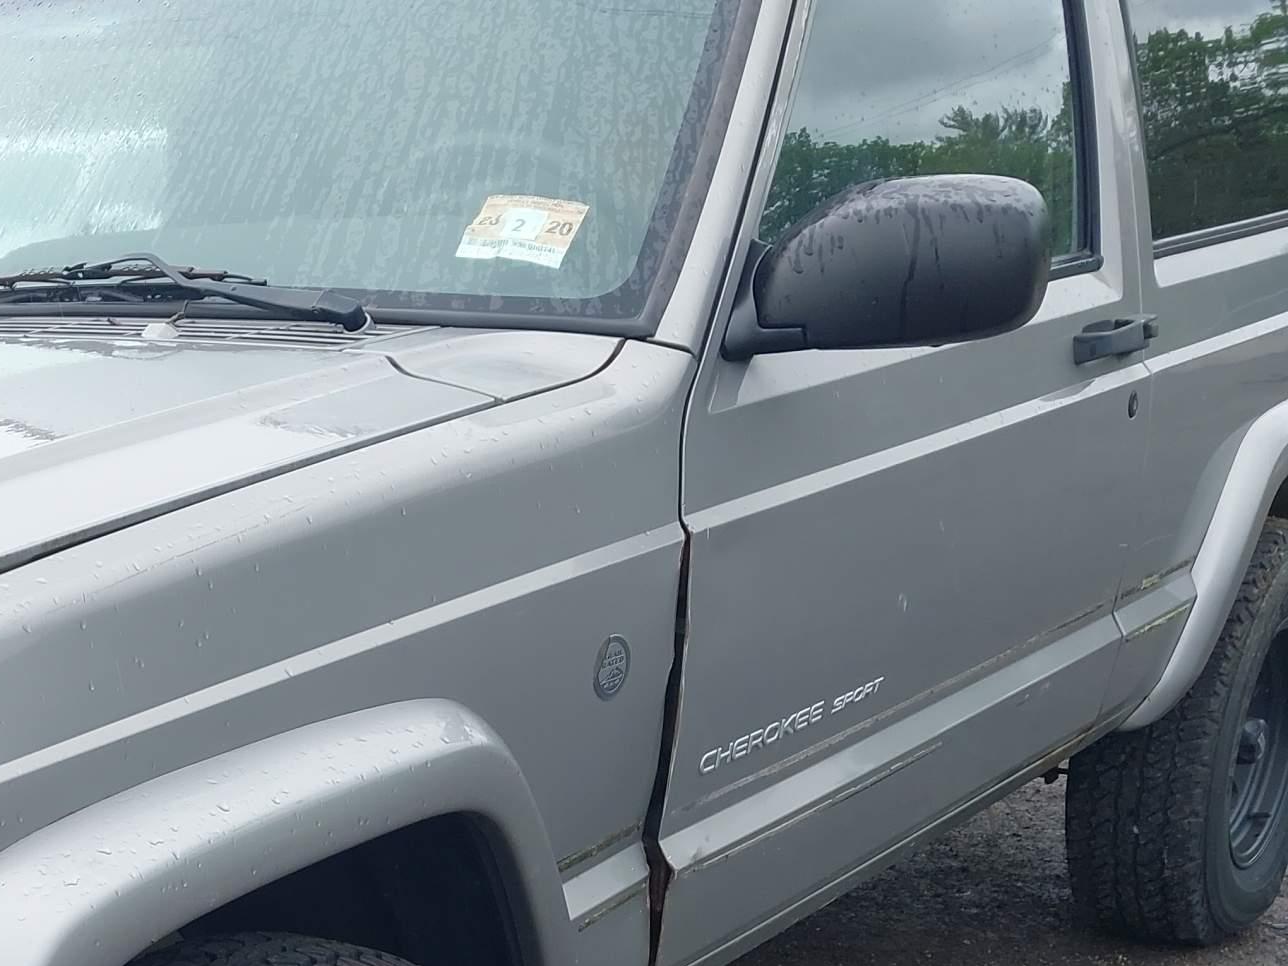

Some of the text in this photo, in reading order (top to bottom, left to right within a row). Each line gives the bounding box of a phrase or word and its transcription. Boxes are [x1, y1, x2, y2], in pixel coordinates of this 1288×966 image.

[512, 218, 526, 232] 2
[545, 220, 573, 236] 20
[699, 676, 885, 774] CHEROKEE SPORT
